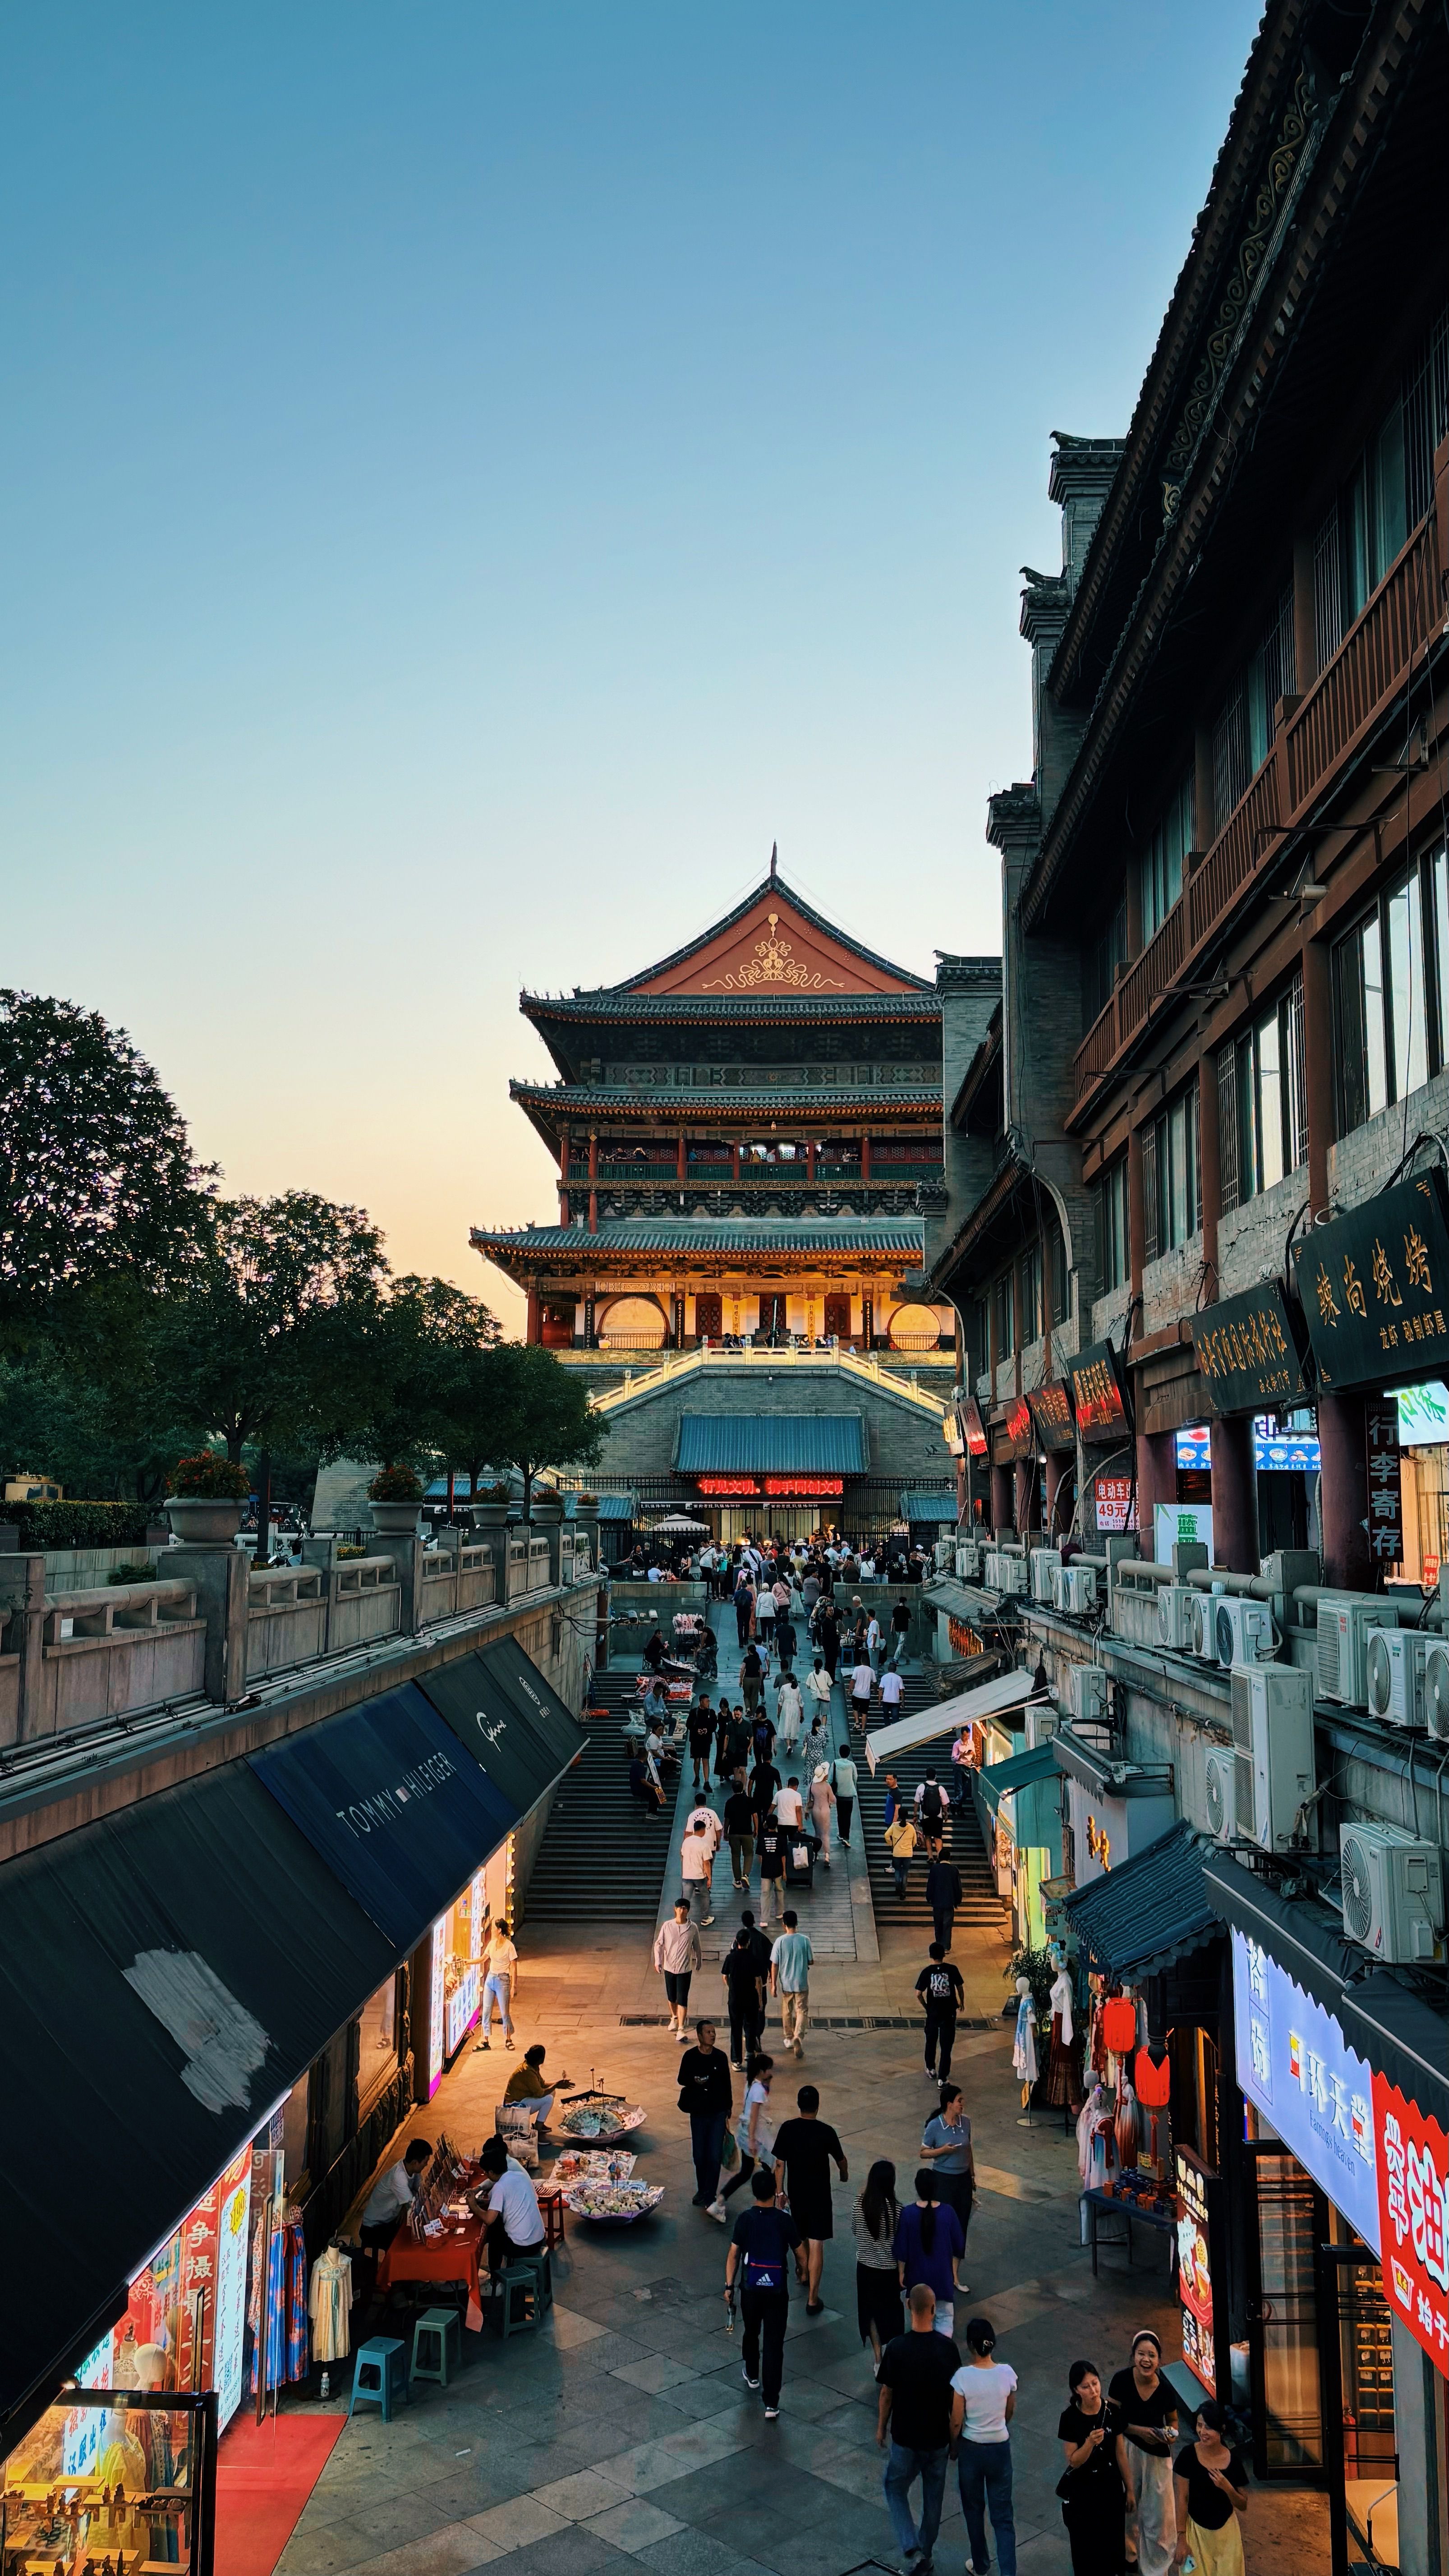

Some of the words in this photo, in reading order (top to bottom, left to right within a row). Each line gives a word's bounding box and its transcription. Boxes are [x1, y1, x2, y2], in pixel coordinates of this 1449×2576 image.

[1099, 1482, 1139, 1500] 电动车出
[1178, 1514, 1198, 1543] 蓝
[1369, 1415, 1401, 1557] 行李寄存
[336, 1789, 402, 1838] TOMMY
[403, 1752, 456, 1799] HILFIGER
[1288, 2029, 1373, 2170] 耳环天堂
[1334, 2137, 1355, 2176] heaven
[1407, 2140, 1449, 2292] 油
